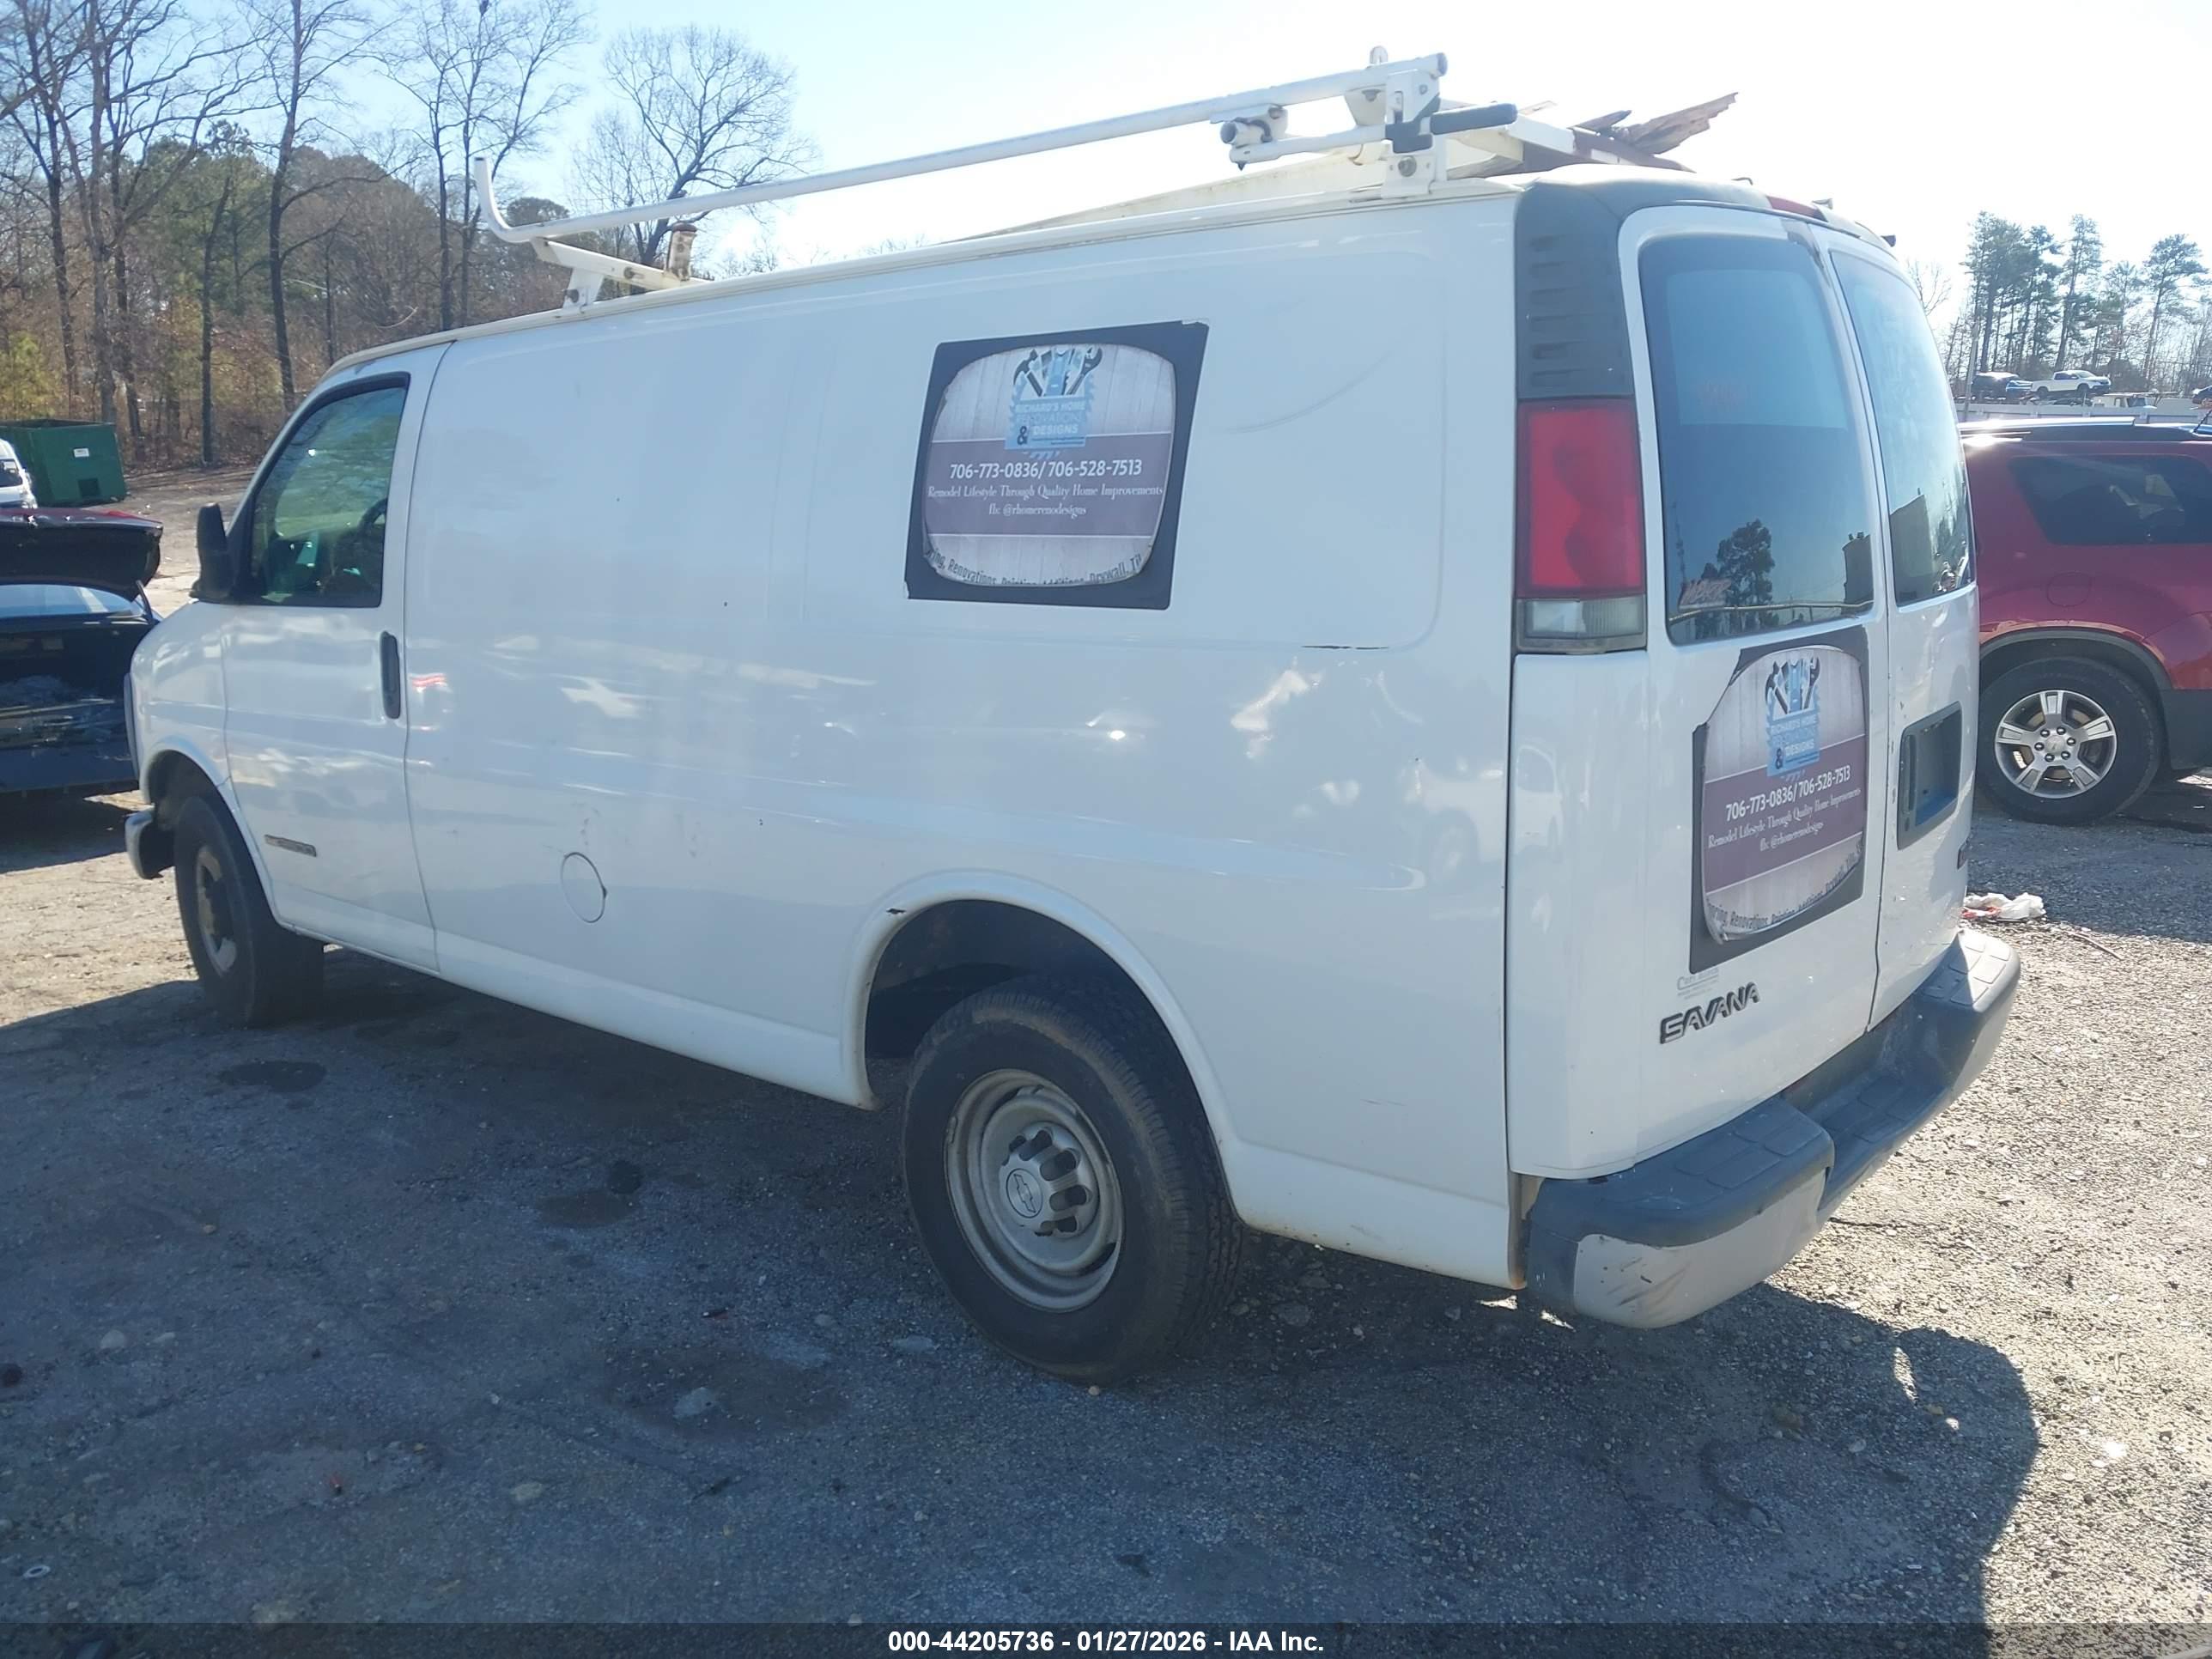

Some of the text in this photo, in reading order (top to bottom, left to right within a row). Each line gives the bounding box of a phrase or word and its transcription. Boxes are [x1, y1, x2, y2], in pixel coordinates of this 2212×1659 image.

[1017, 426, 1028, 446] &
[1031, 423, 1079, 437] DESIGNS
[927, 483, 1164, 501] Remodel Lifestyle Through Quality Home Improvements
[1708, 830, 1738, 848] Remodel
[1767, 811, 1792, 828] Through
[1660, 981, 1760, 1044] SAVANA
